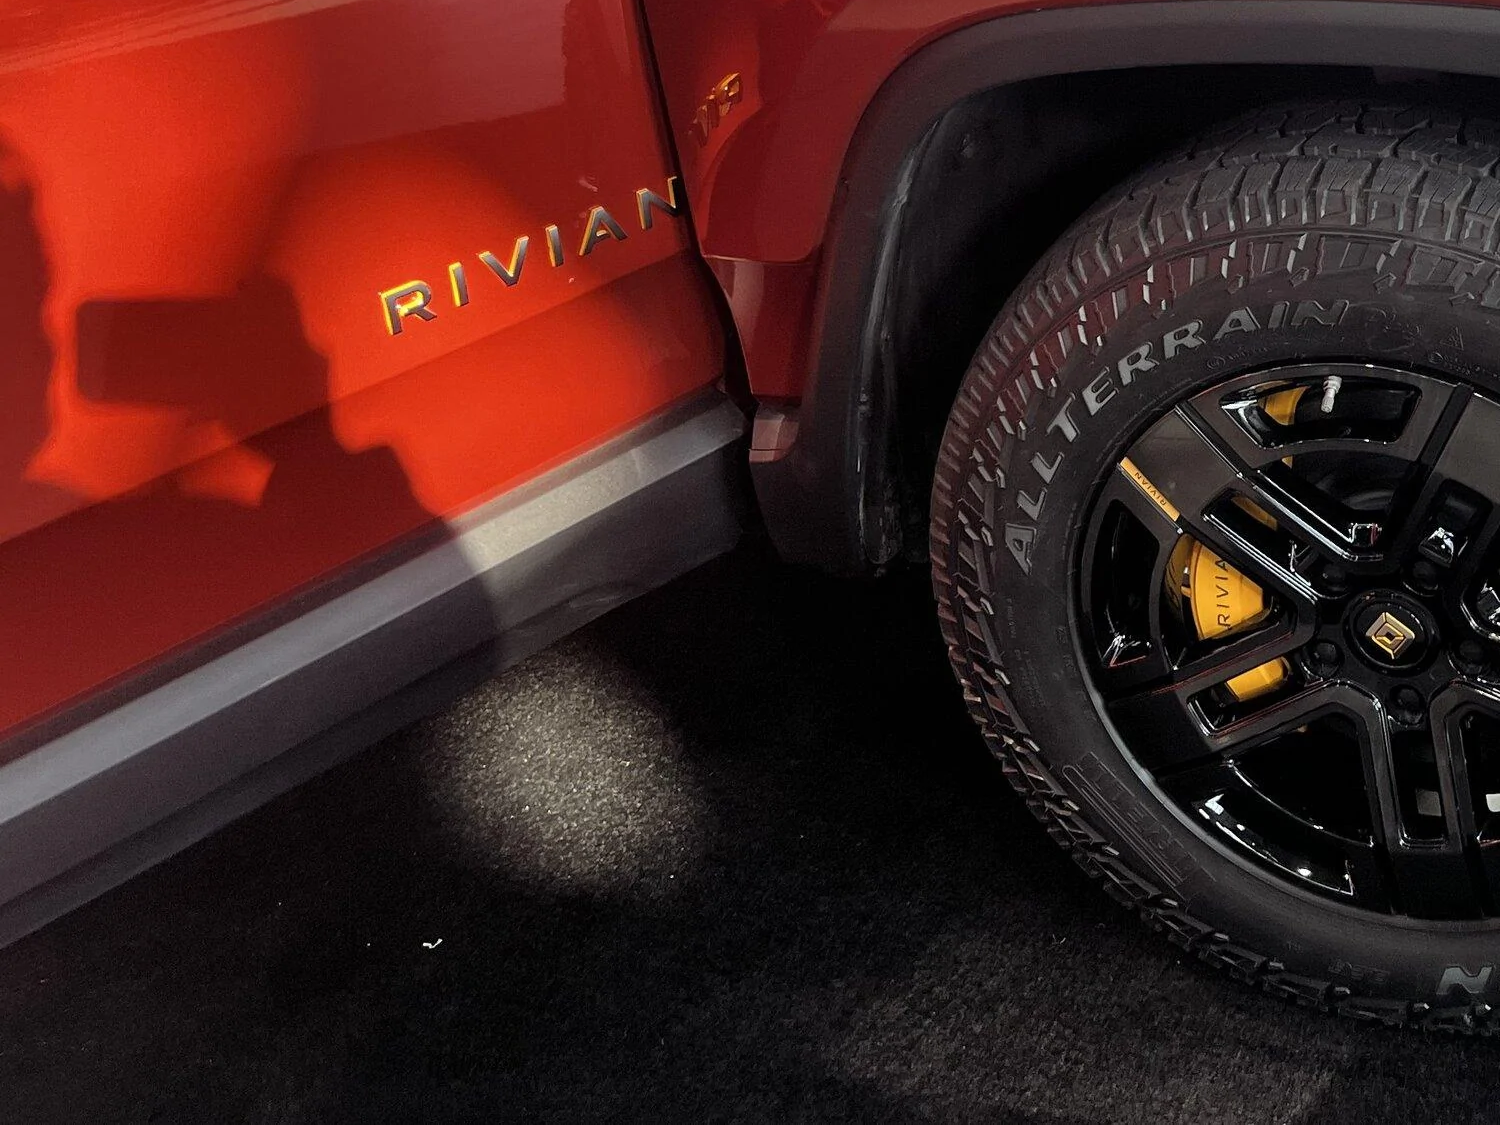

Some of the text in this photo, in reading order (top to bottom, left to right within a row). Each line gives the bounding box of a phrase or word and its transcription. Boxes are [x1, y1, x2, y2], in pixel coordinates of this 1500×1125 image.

[378, 175, 685, 336] RIVIAN
[1005, 299, 1351, 576] ALL TERRAIN
[1134, 471, 1168, 506] RIVIAN
[1214, 558, 1233, 630] RIVIA
